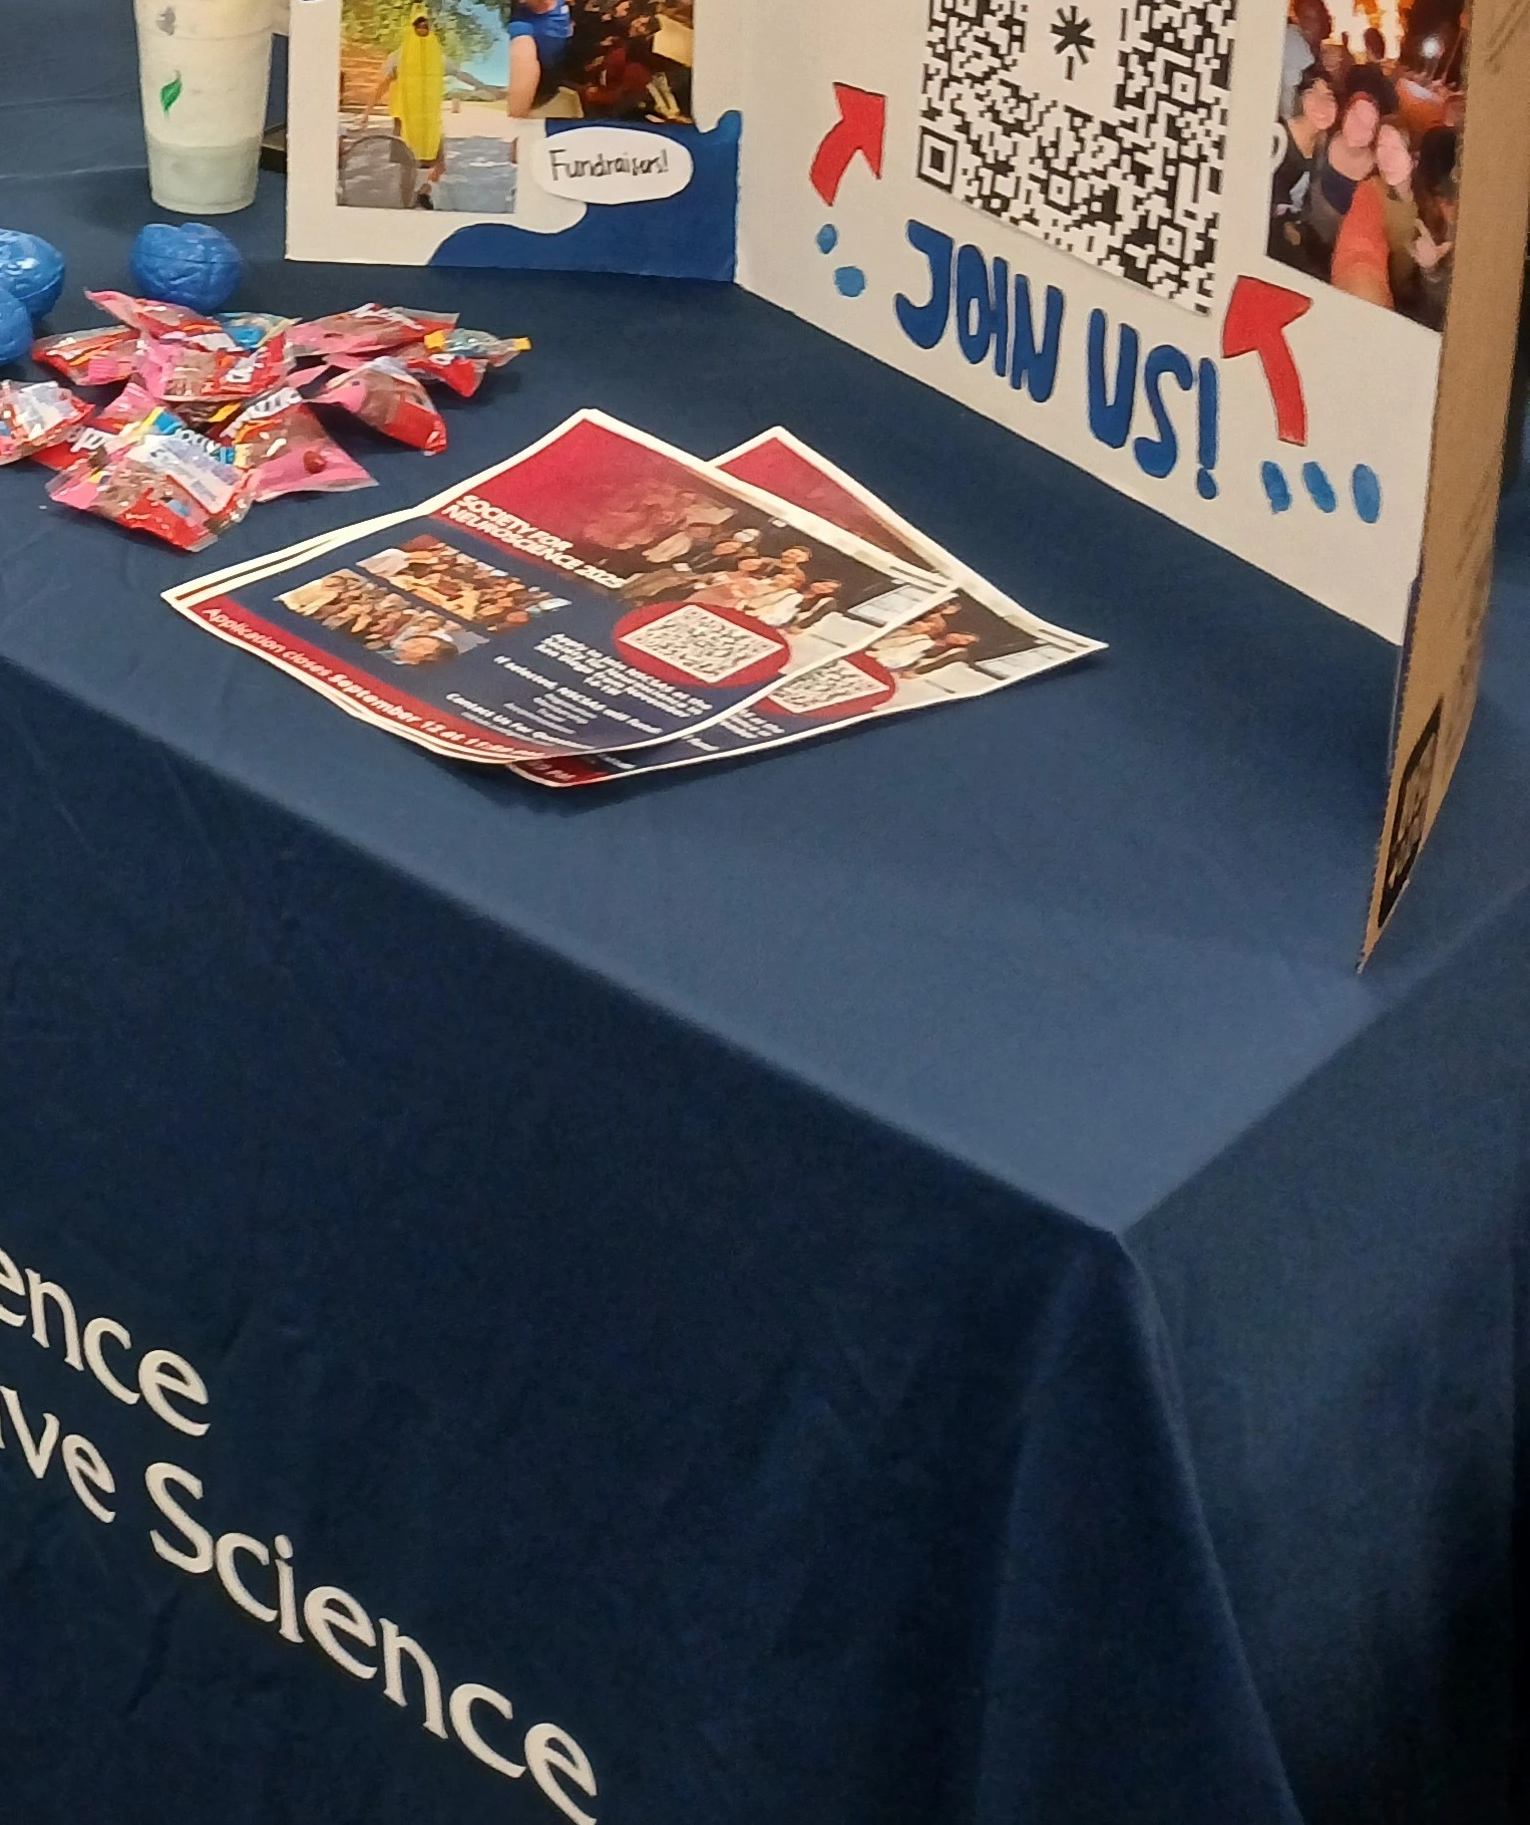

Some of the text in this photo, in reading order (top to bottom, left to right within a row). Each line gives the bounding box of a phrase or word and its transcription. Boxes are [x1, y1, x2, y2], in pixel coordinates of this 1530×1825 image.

[894, 219, 1220, 500] JOIN US!
[441, 504, 585, 571] NEUROSCIENCE
[456, 494, 574, 552] SOCIETY FOR
[202, 608, 287, 654] Application
[281, 649, 333, 678] closes
[327, 673, 423, 724] September
[143, 1461, 598, 1825] Science
